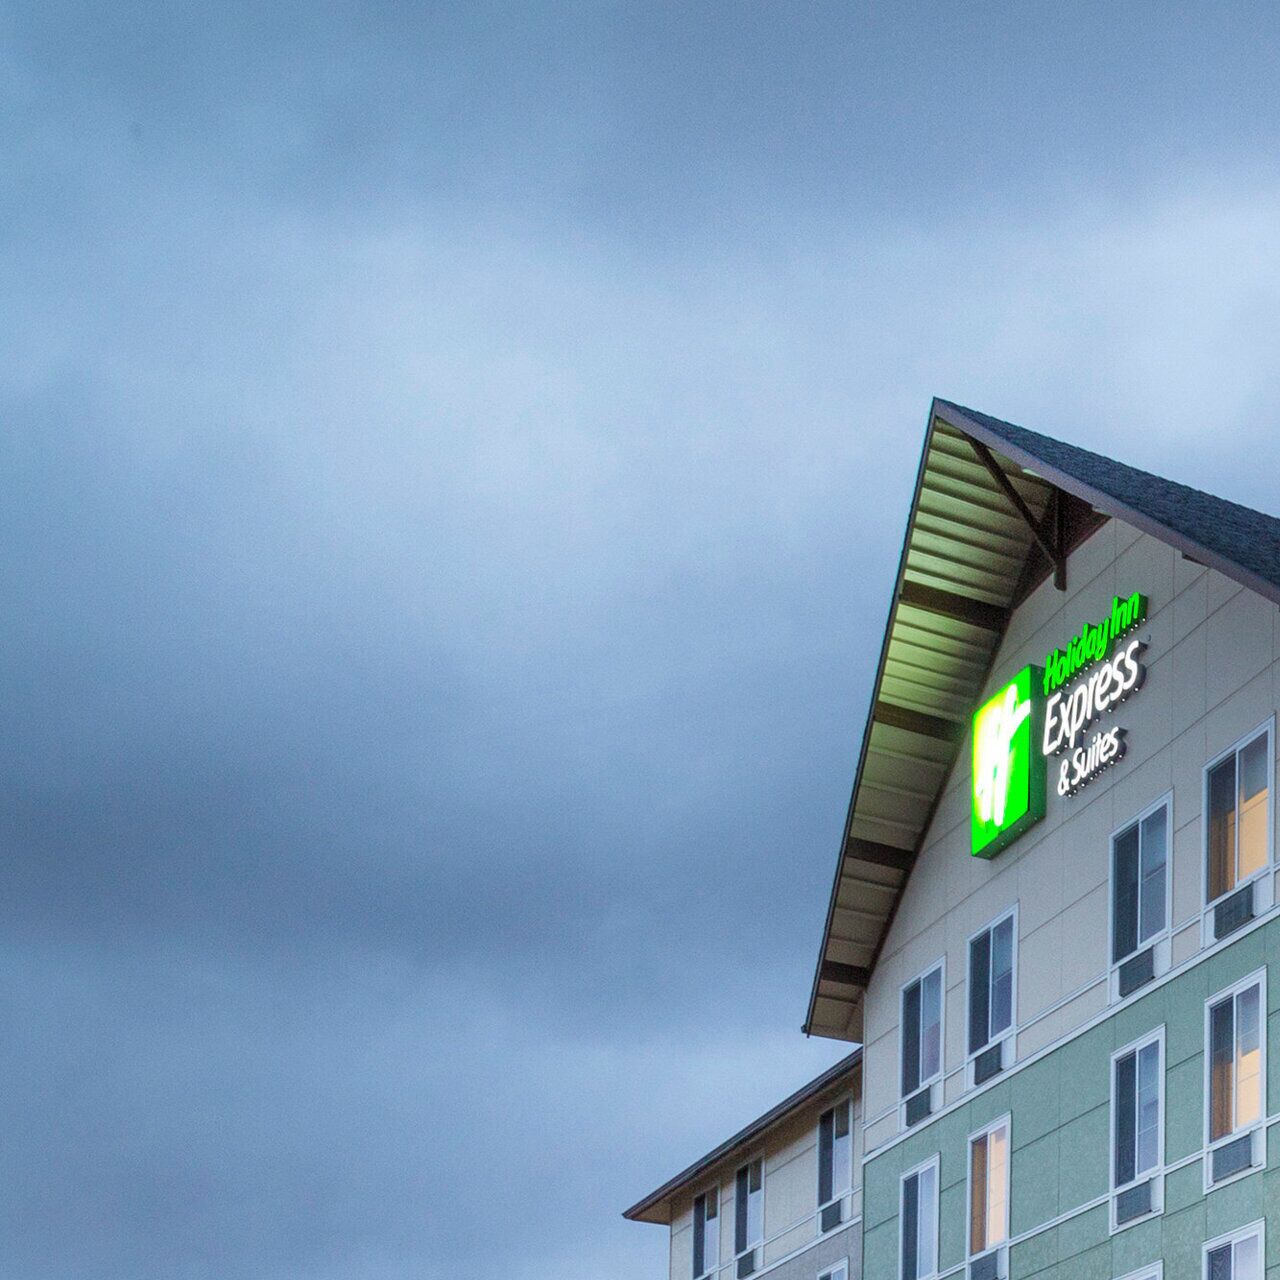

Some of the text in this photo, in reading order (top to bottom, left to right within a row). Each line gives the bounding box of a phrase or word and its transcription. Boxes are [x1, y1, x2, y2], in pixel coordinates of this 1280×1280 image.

[1043, 592, 1140, 696] Holiday Inn
[1042, 640, 1140, 755] Express
[1057, 726, 1120, 796] & Suites
